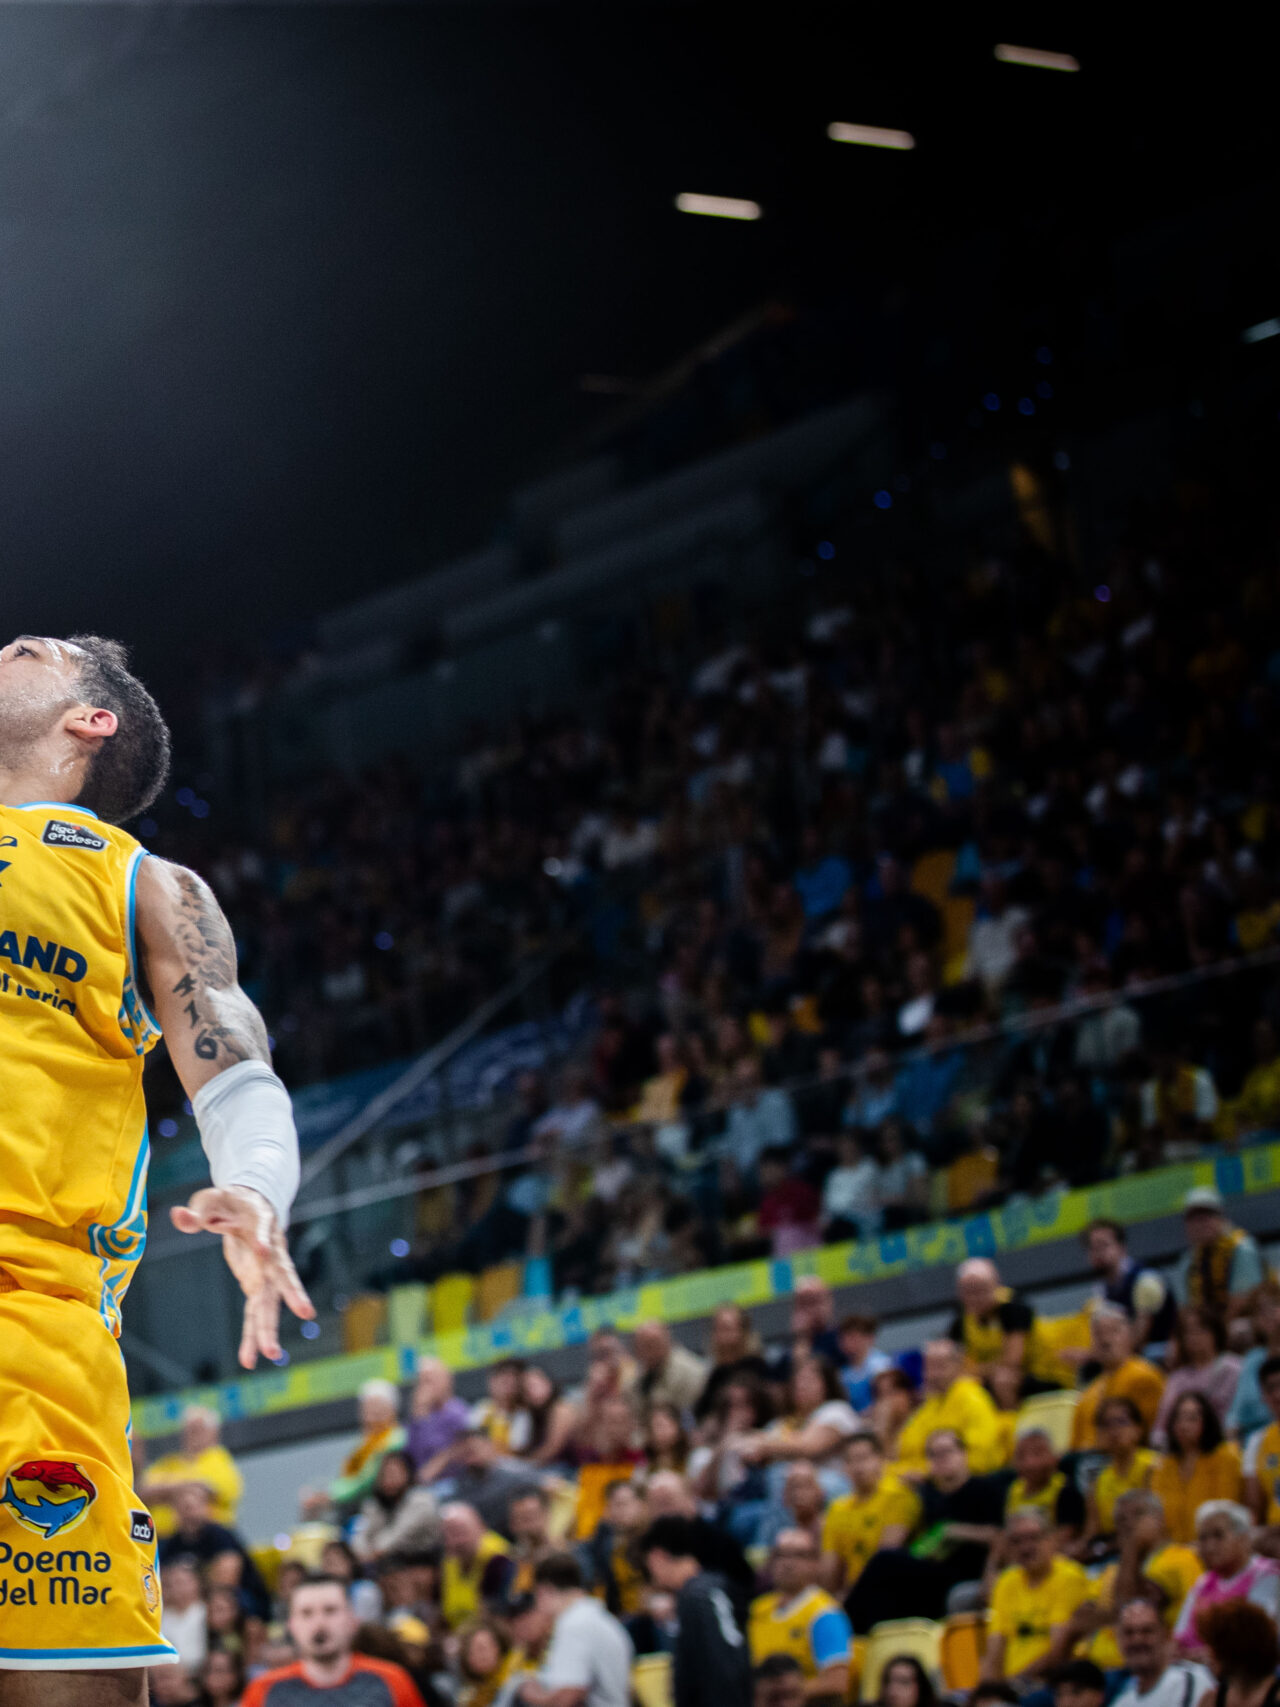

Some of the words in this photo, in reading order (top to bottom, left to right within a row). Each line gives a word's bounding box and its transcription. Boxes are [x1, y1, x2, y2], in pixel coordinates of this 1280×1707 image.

[51, 824, 76, 834] liga
[48, 832, 101, 847] endesa
[133, 1524, 151, 1539] acb
[49, 1576, 112, 1605] Mar
